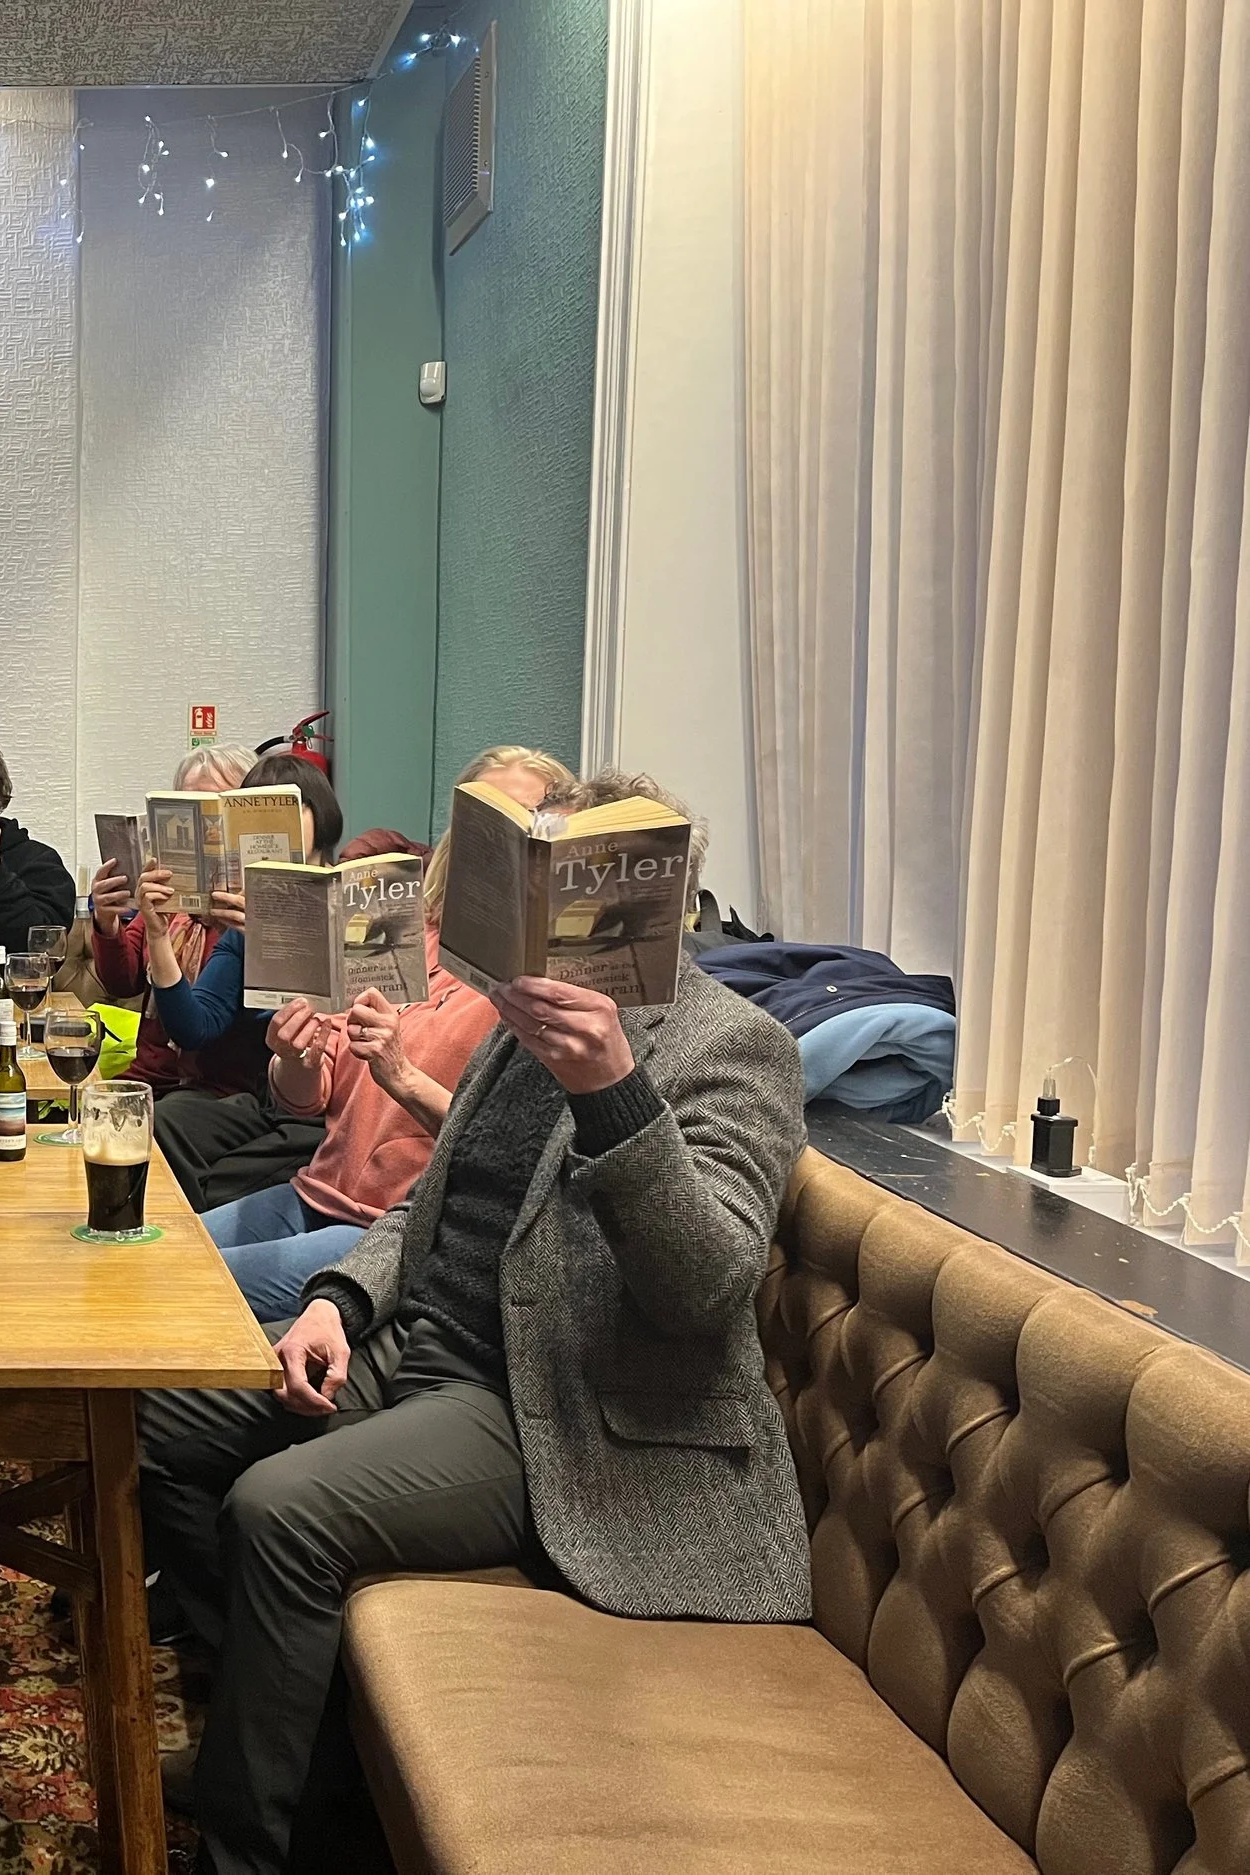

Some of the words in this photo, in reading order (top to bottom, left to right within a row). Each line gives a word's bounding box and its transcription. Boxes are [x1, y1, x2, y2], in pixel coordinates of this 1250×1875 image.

[224, 797, 261, 808] ANNE
[262, 795, 299, 807] TYLER
[566, 841, 619, 858] Anne
[350, 869, 378, 881] Anne
[555, 853, 684, 895] Tyler
[343, 878, 421, 910] Tyler
[348, 964, 380, 976] Dinner
[559, 961, 609, 981] Dinner
[575, 972, 630, 988] omesick
[346, 983, 406, 996] Resturan
